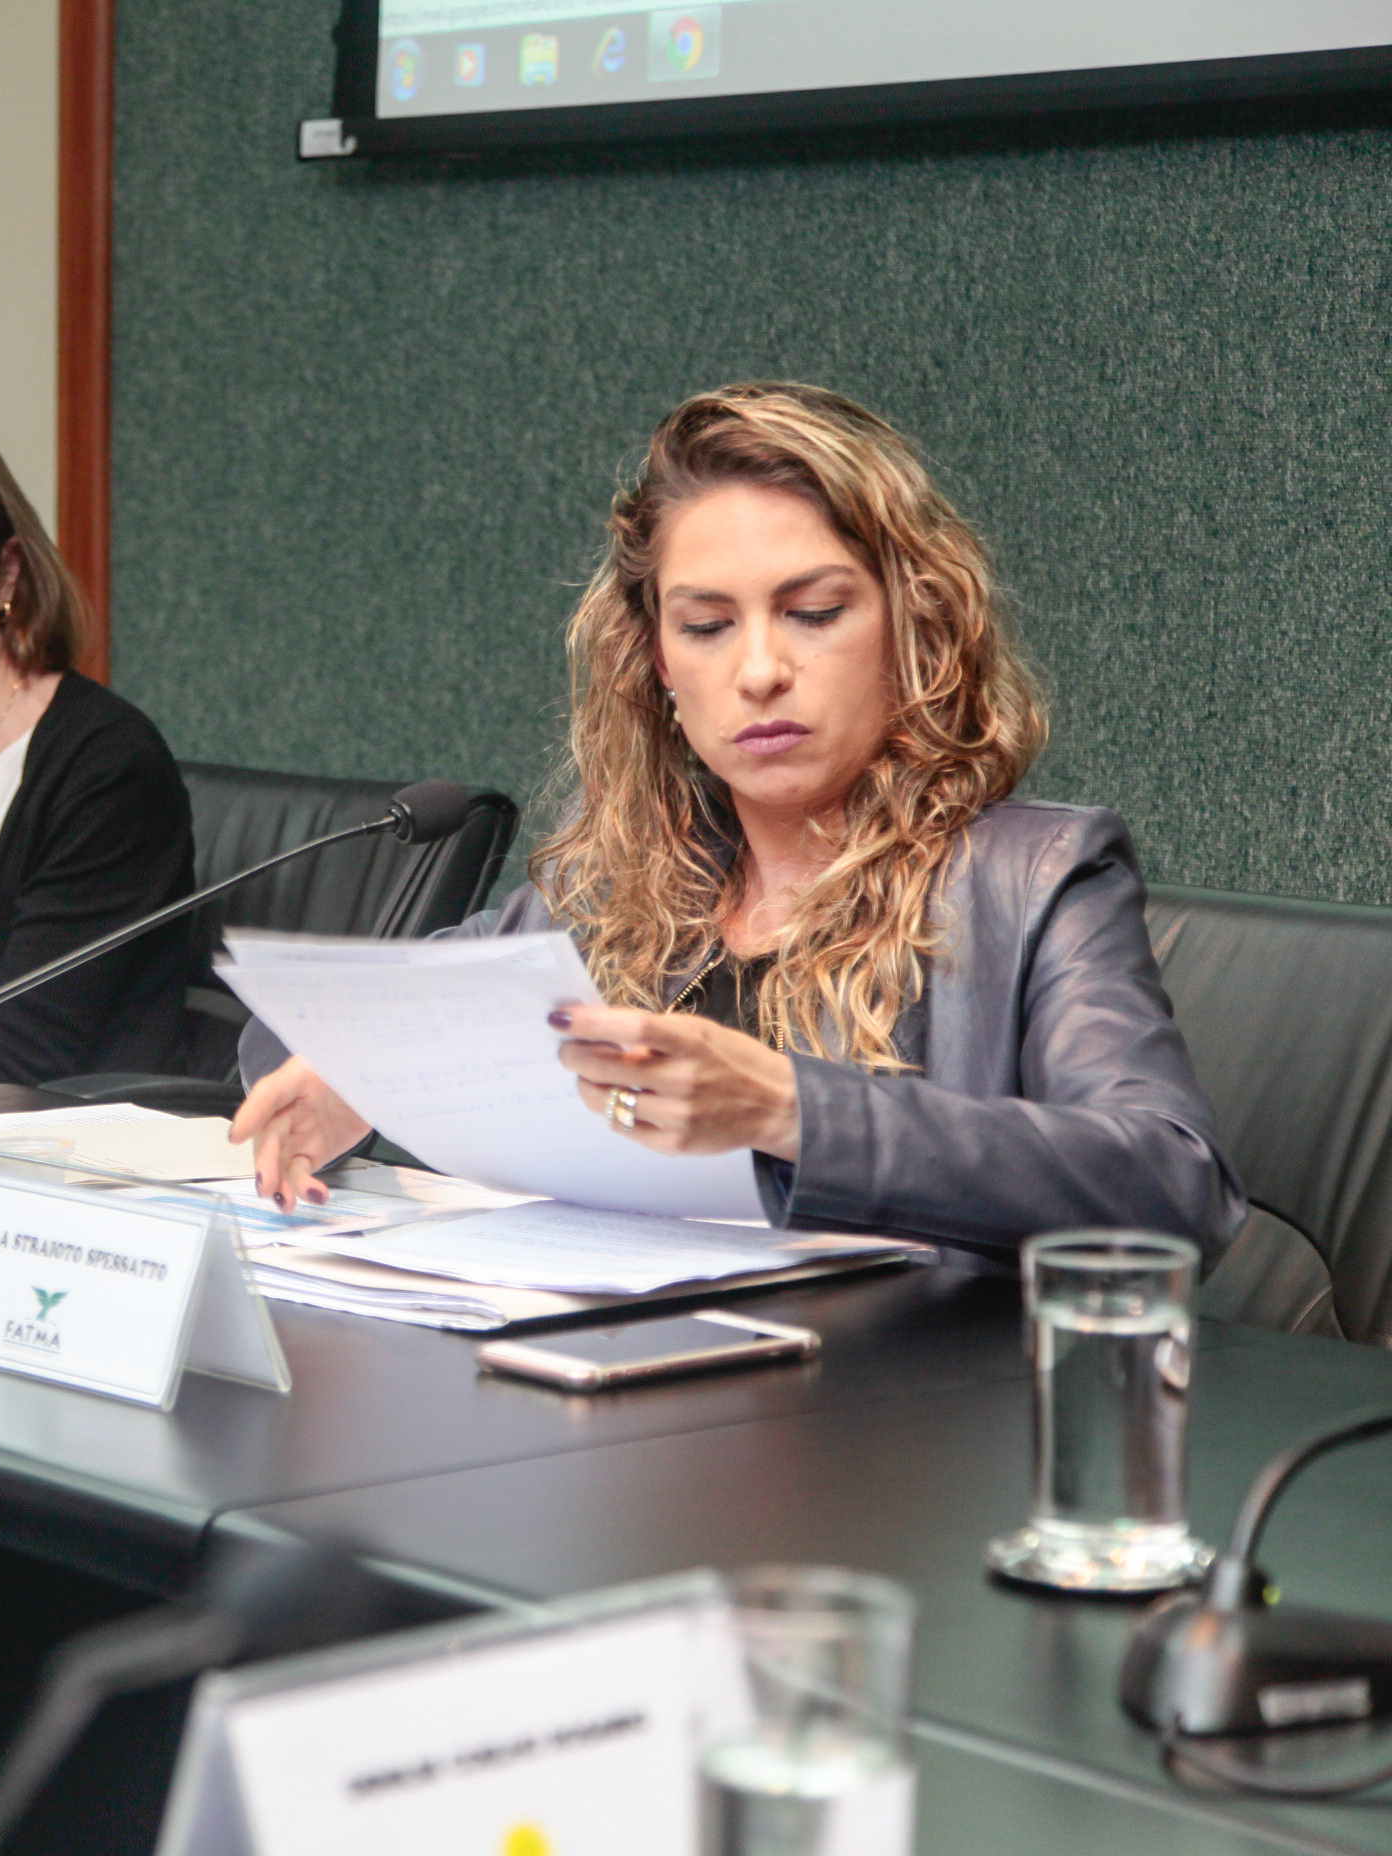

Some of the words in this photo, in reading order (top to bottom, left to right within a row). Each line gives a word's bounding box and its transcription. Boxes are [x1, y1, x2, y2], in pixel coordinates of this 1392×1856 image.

[12, 1233, 83, 1264] STRAIOTO
[86, 1249, 168, 1281] SPESSATTO
[5, 1320, 60, 1349] FATMA
